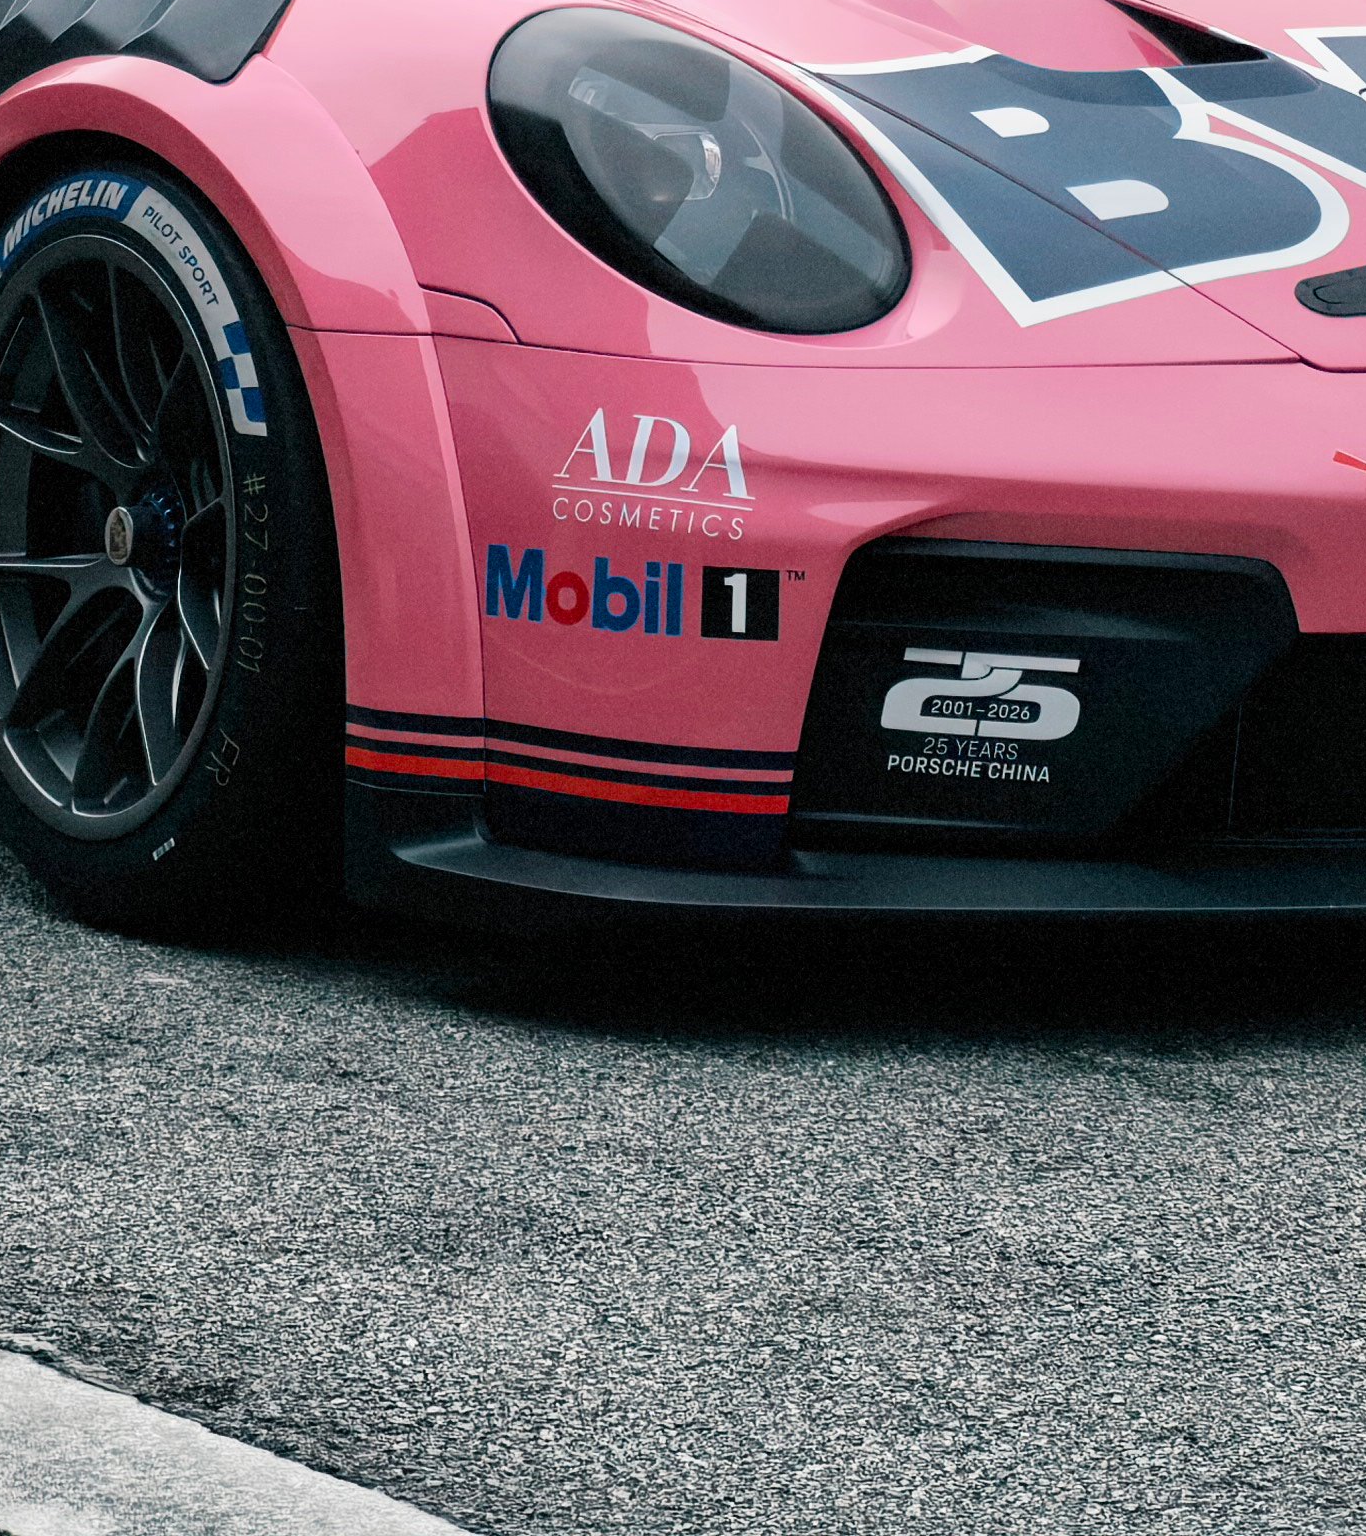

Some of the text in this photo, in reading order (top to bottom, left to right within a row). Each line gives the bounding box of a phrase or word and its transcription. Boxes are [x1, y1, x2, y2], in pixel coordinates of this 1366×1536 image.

[3, 180, 129, 251] MICHELIN
[143, 206, 219, 306] PILOT SPORT
[553, 407, 756, 500] ADA
[553, 498, 745, 540] COSMETICS
[486, 543, 684, 637] Mobil
[723, 572, 748, 634] 1
[887, 754, 1050, 783] PORSCHE CHINA
[923, 736, 1019, 760] 25 YEARS
